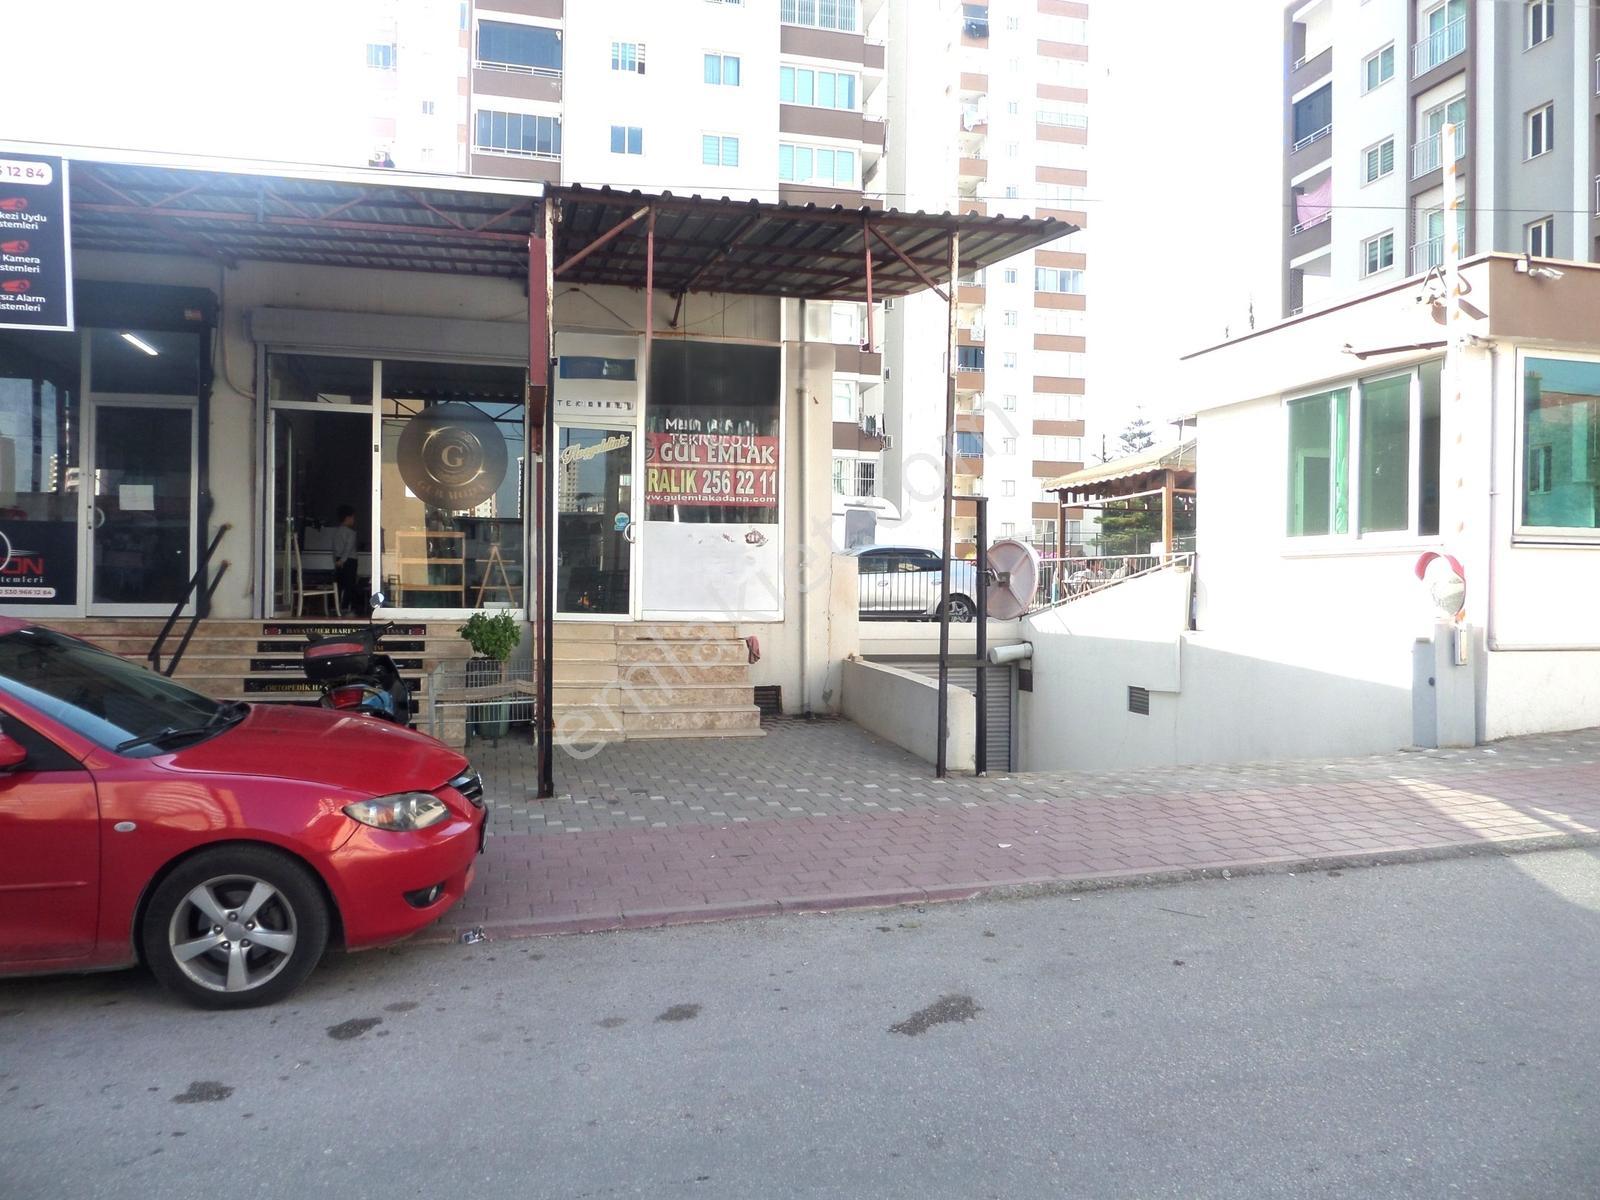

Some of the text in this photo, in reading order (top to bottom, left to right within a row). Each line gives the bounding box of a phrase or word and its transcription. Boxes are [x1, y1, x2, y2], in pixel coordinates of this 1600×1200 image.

[7, 166, 21, 177] 12
[26, 168, 45, 178] 84
[21, 213, 48, 222] Uydu
[2, 254, 41, 264] Kamera
[16, 294, 46, 303] Alarm
[441, 445, 464, 468] G
[702, 469, 731, 494] 256
[735, 470, 755, 495] 22
[759, 470, 776, 495] 11
